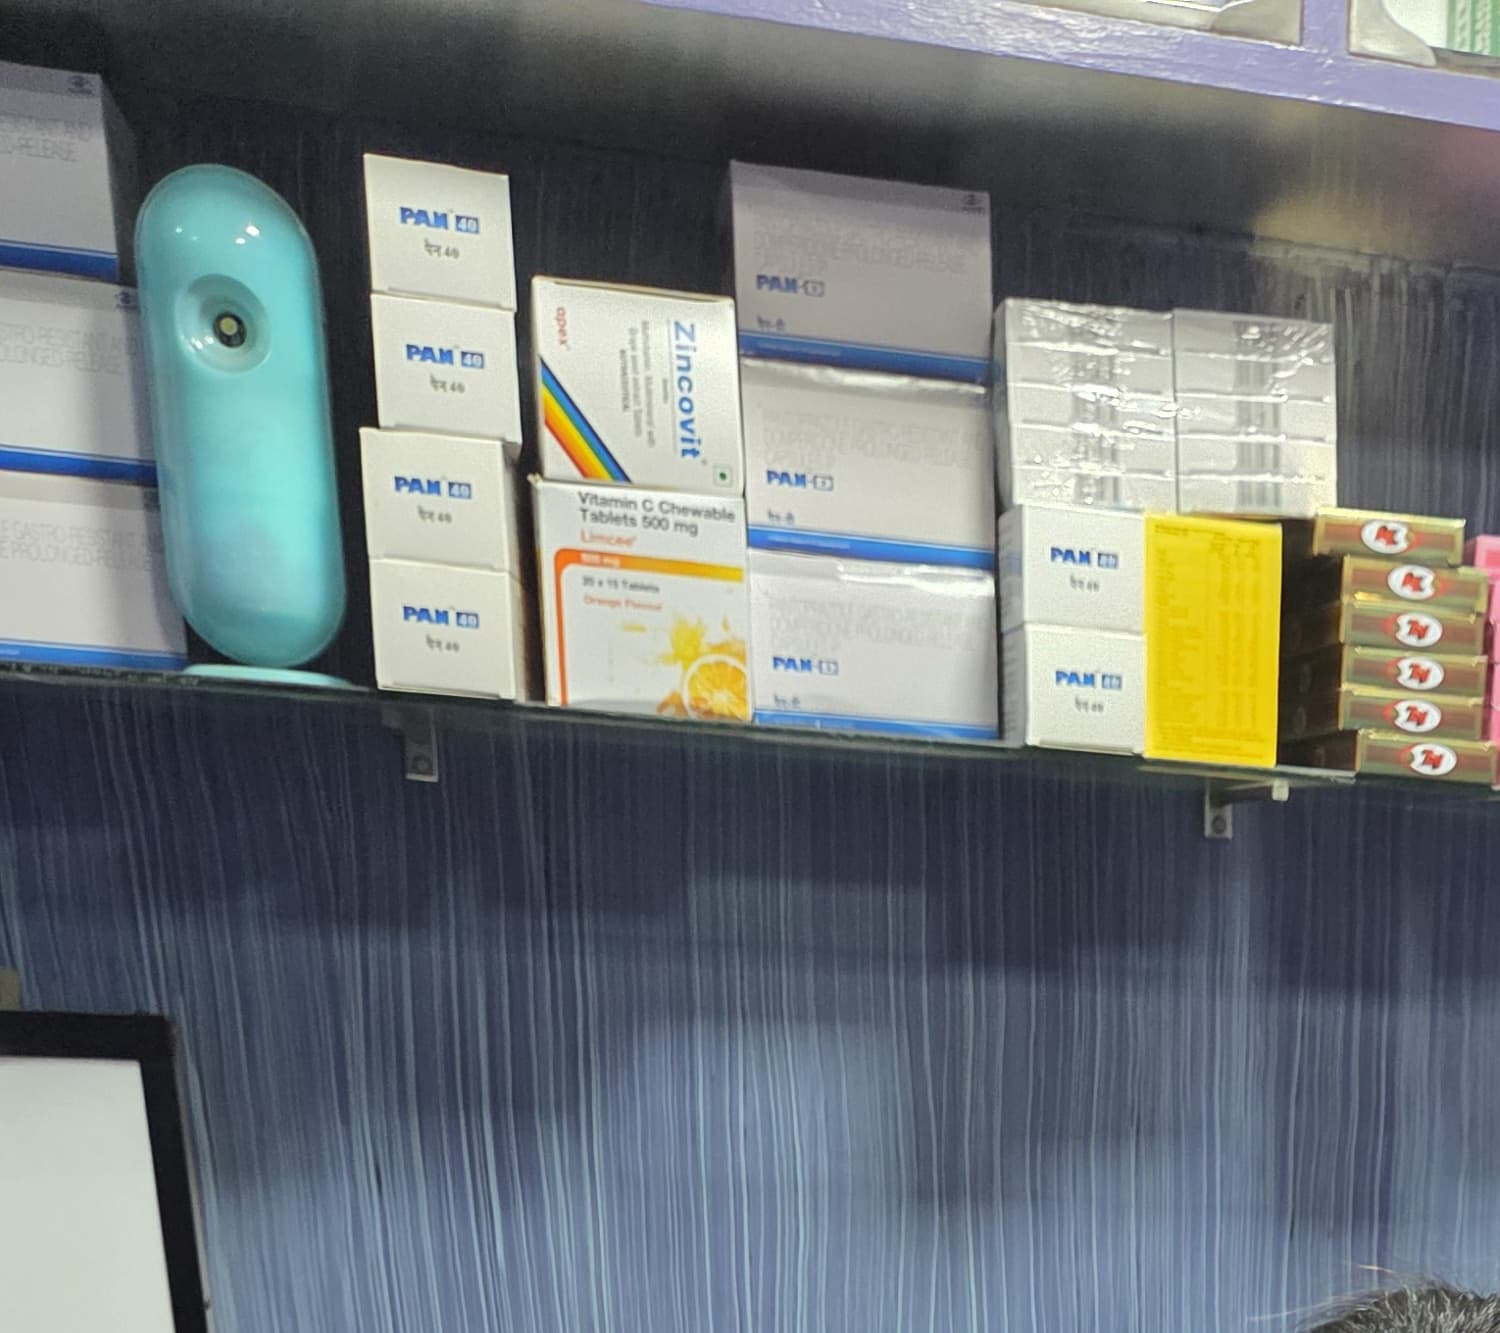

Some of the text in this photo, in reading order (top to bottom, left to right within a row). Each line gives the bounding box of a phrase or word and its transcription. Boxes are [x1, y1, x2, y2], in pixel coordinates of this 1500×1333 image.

[400, 206, 479, 234] PAN 40
[556, 306, 567, 346] apex
[405, 343, 484, 369] PAN 40
[674, 320, 702, 460] Zincovit
[394, 475, 471, 499] PAN 40
[578, 491, 736, 523] Vitamin C Chewable
[579, 508, 699, 538] Tablets 500 mg
[1050, 546, 1091, 566] PAN
[403, 605, 479, 629] PAN 40
[1055, 670, 1096, 688] PAN
